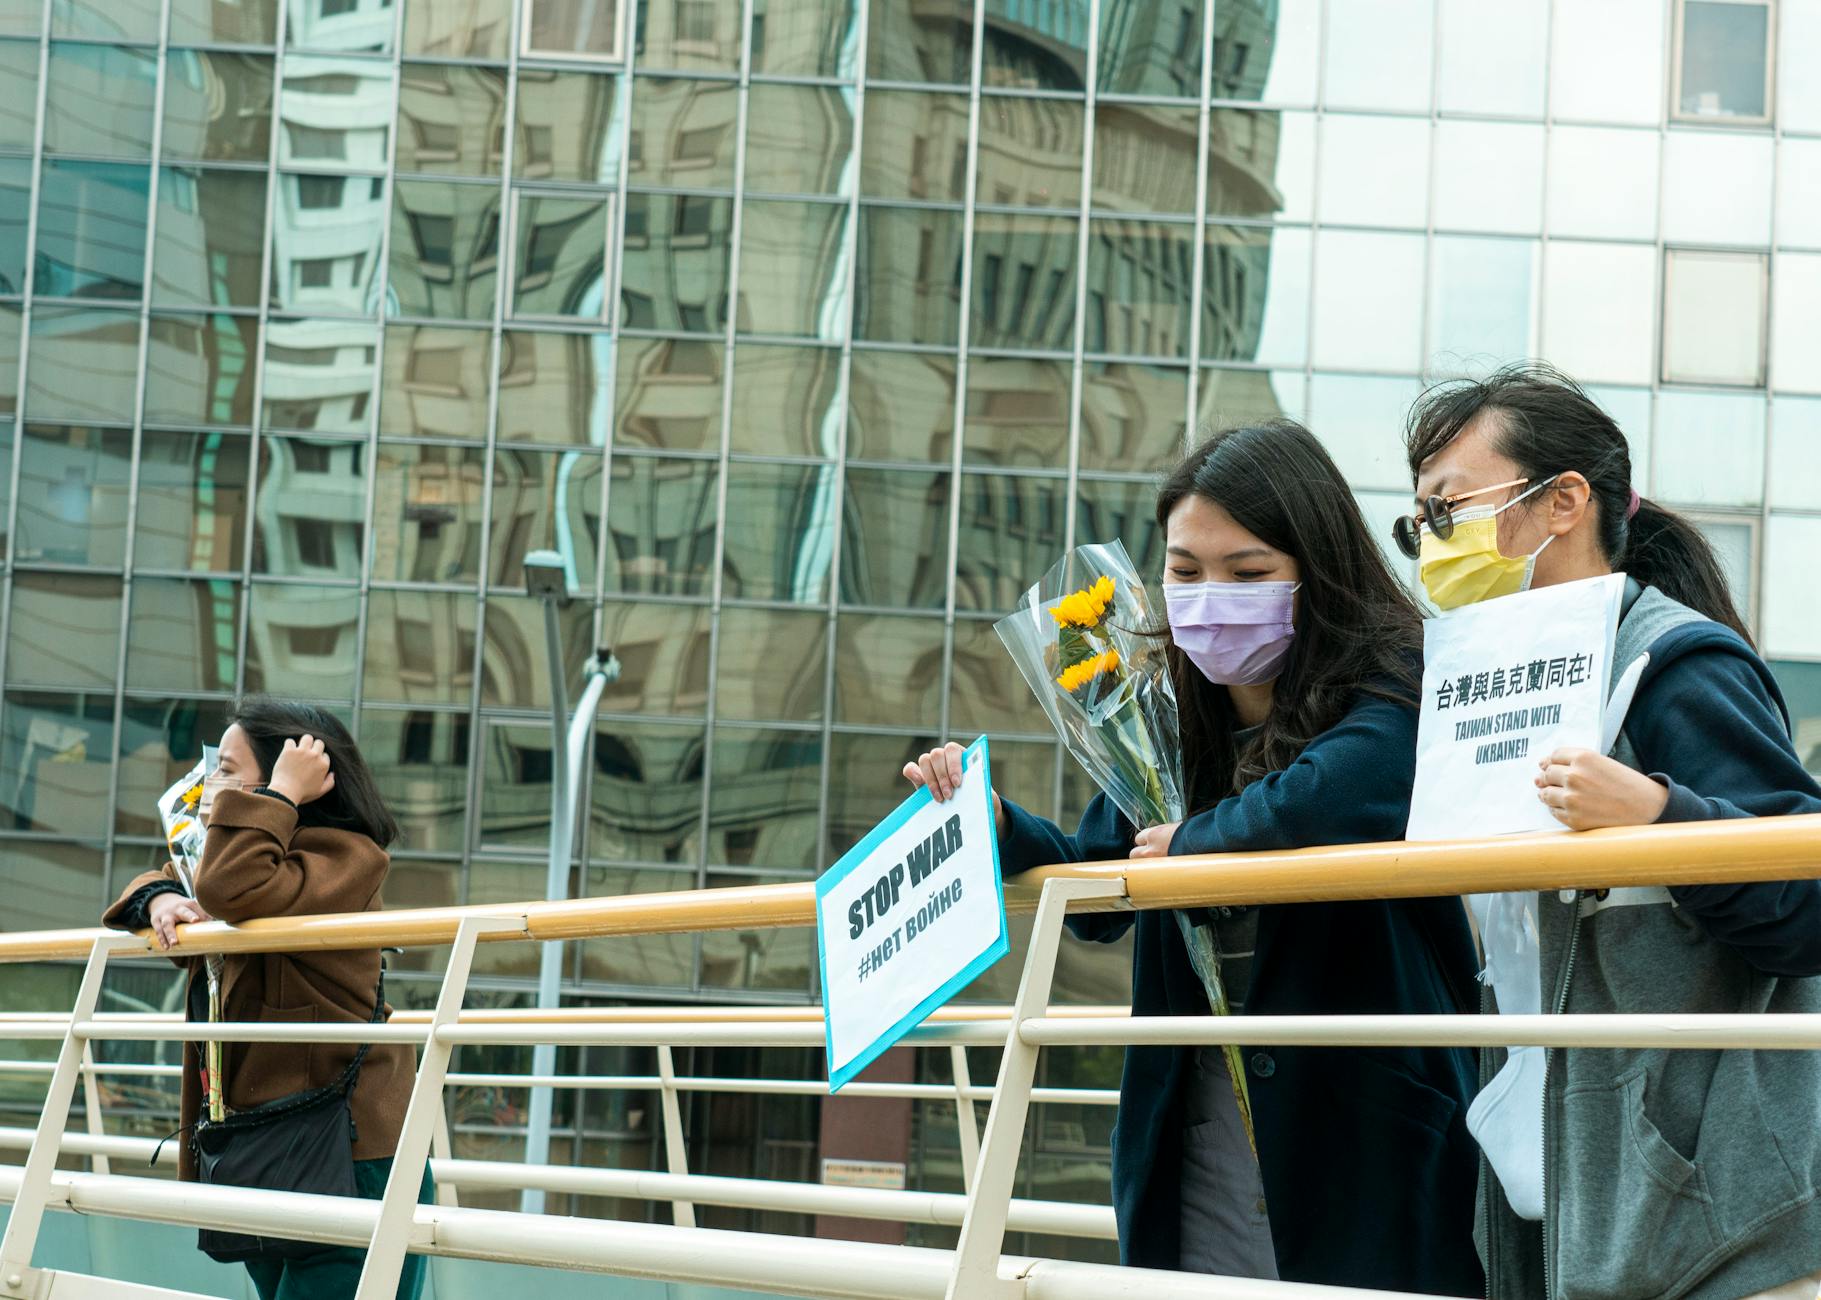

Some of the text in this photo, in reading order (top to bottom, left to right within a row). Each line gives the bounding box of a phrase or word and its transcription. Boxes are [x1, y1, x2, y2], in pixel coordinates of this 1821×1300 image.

[1436, 653, 1593, 711] 台灣與烏克蘭同在!
[1455, 704, 1561, 741] TAIWAN STAND WITH
[1475, 738, 1529, 765] UKRAINE!!
[848, 813, 963, 940] STOP WAR
[858, 877, 963, 983] #нет войне
